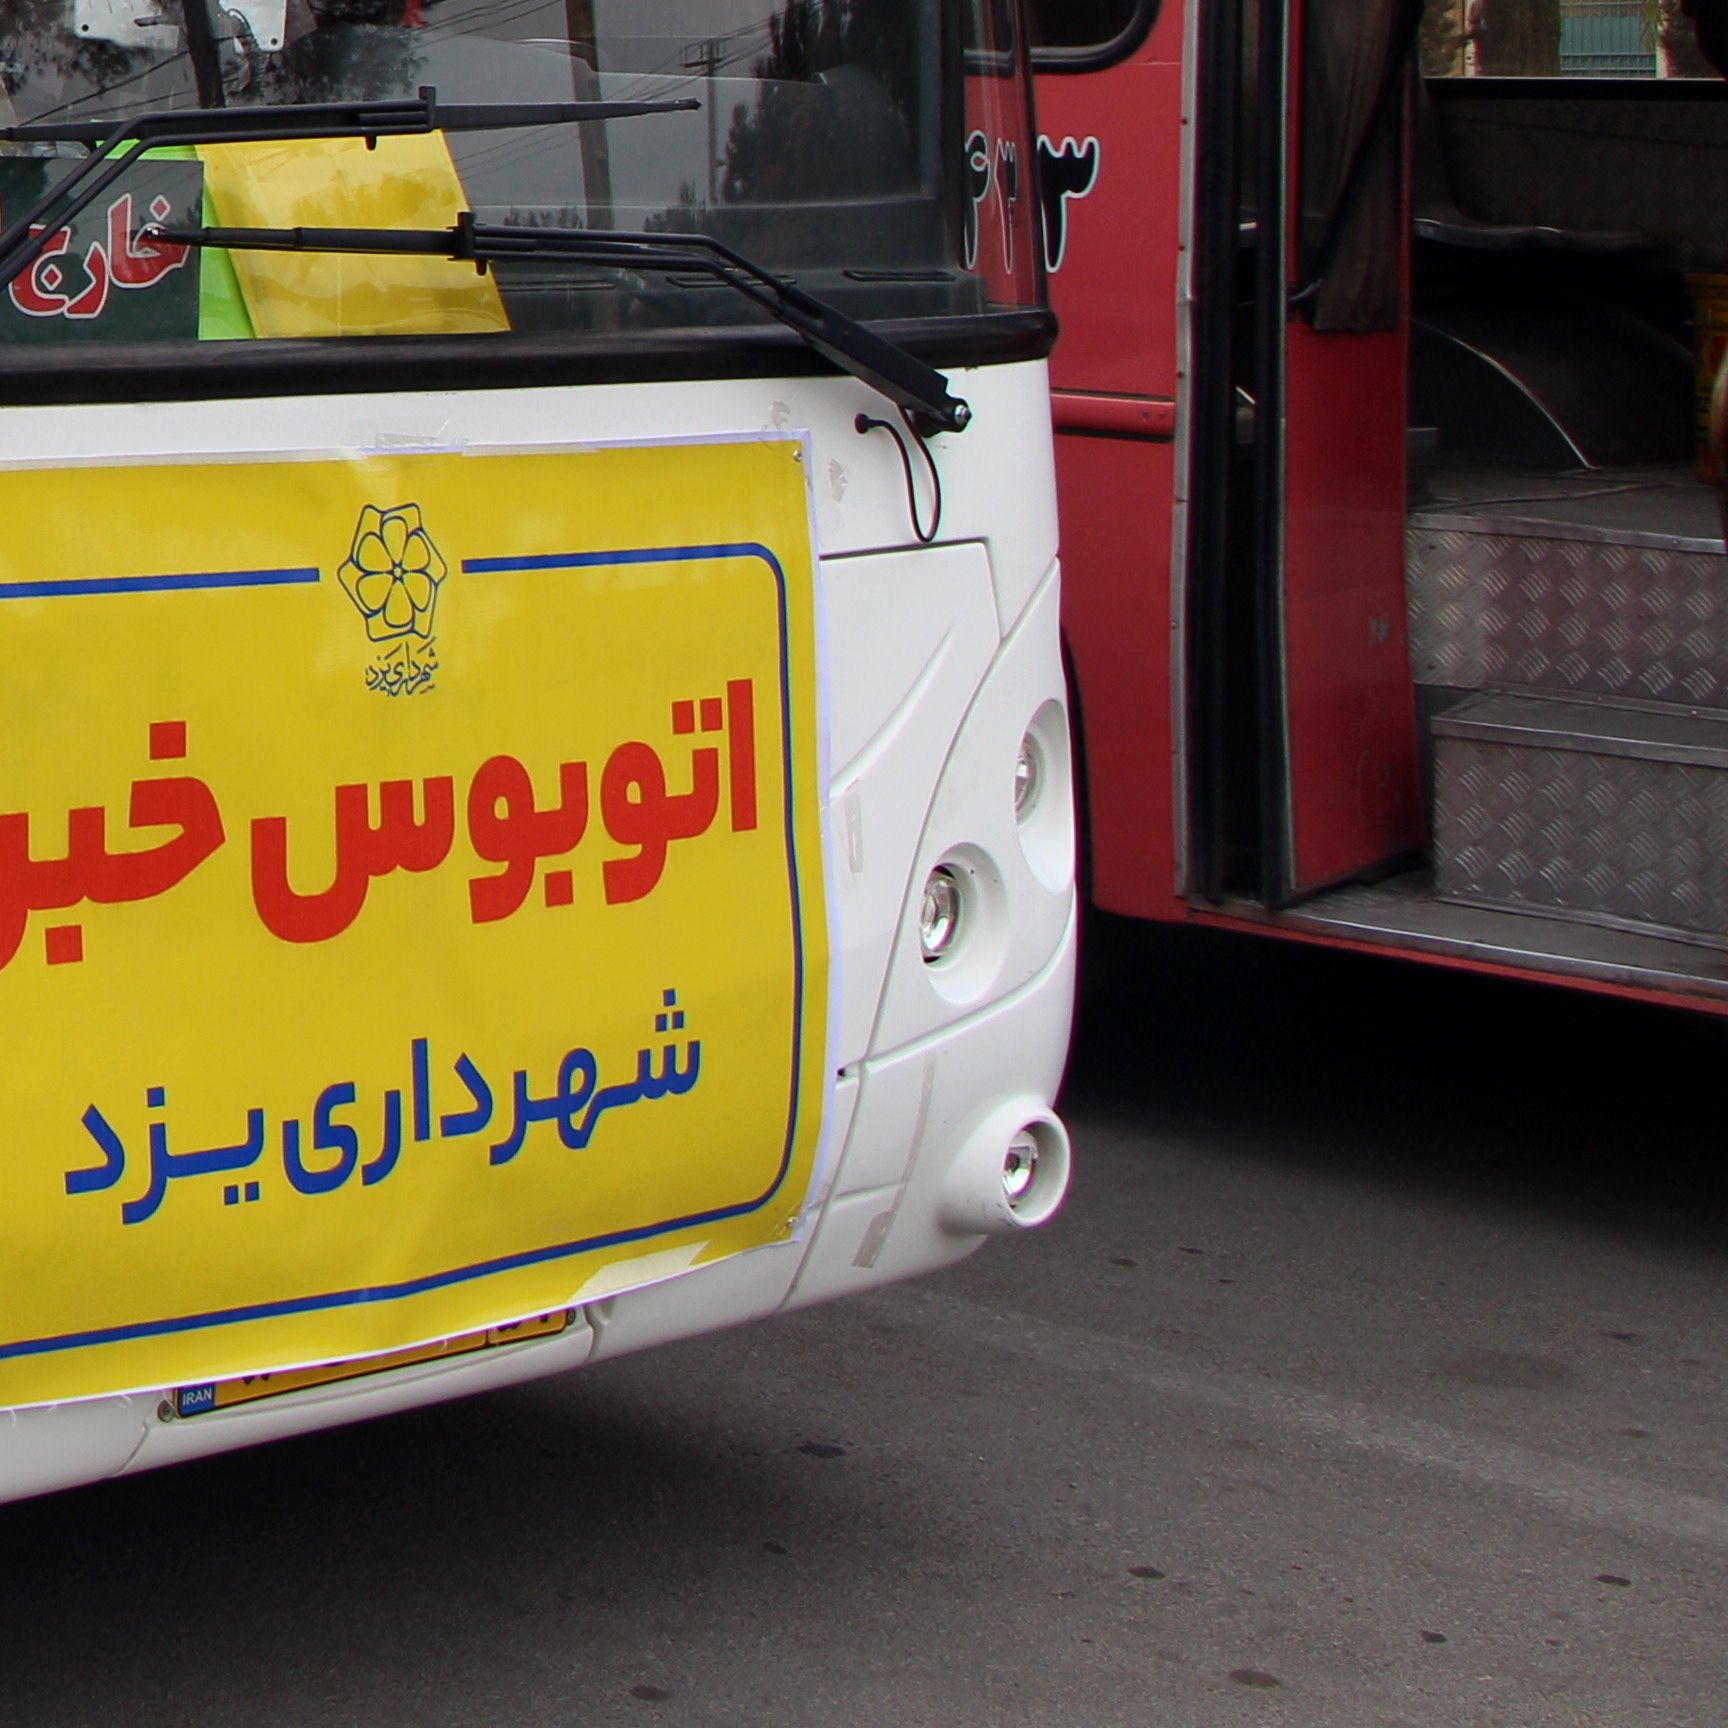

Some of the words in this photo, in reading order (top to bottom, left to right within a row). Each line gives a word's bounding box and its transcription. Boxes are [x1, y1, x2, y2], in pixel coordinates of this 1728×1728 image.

[7, 192, 191, 319] خارج
[250, 677, 759, 945] اتوبوس
[63, 1084, 264, 1226] یزد
[281, 988, 704, 1199] شهرداری
[181, 1377, 213, 1406] IRAN
